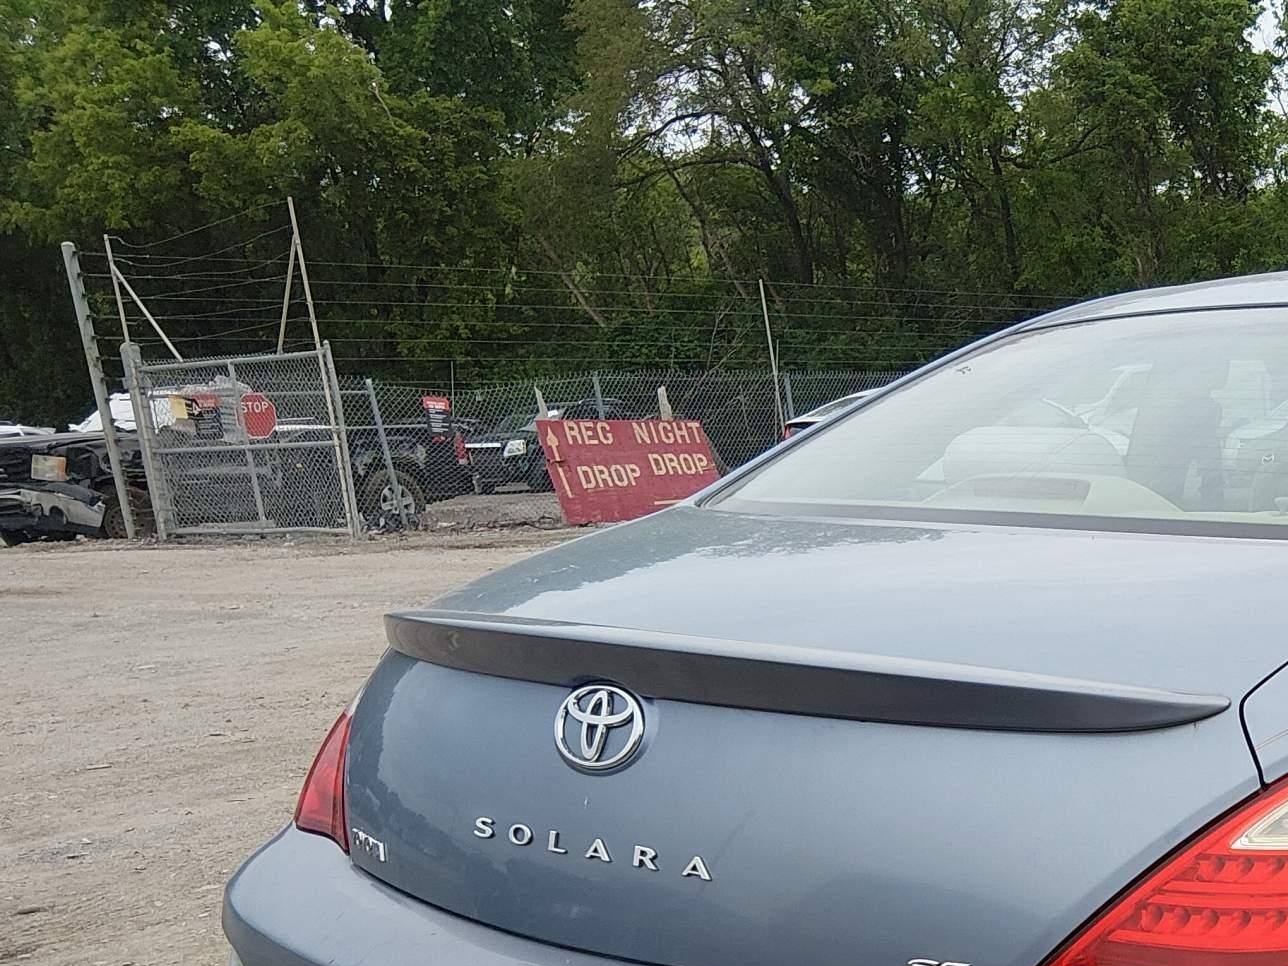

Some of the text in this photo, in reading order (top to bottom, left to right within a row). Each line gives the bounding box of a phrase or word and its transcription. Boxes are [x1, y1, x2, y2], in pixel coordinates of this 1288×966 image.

[240, 400, 269, 414] STOP
[563, 421, 702, 445] REG NIGHT
[577, 453, 708, 489] DROP DROP
[473, 816, 712, 881] SOLARA
